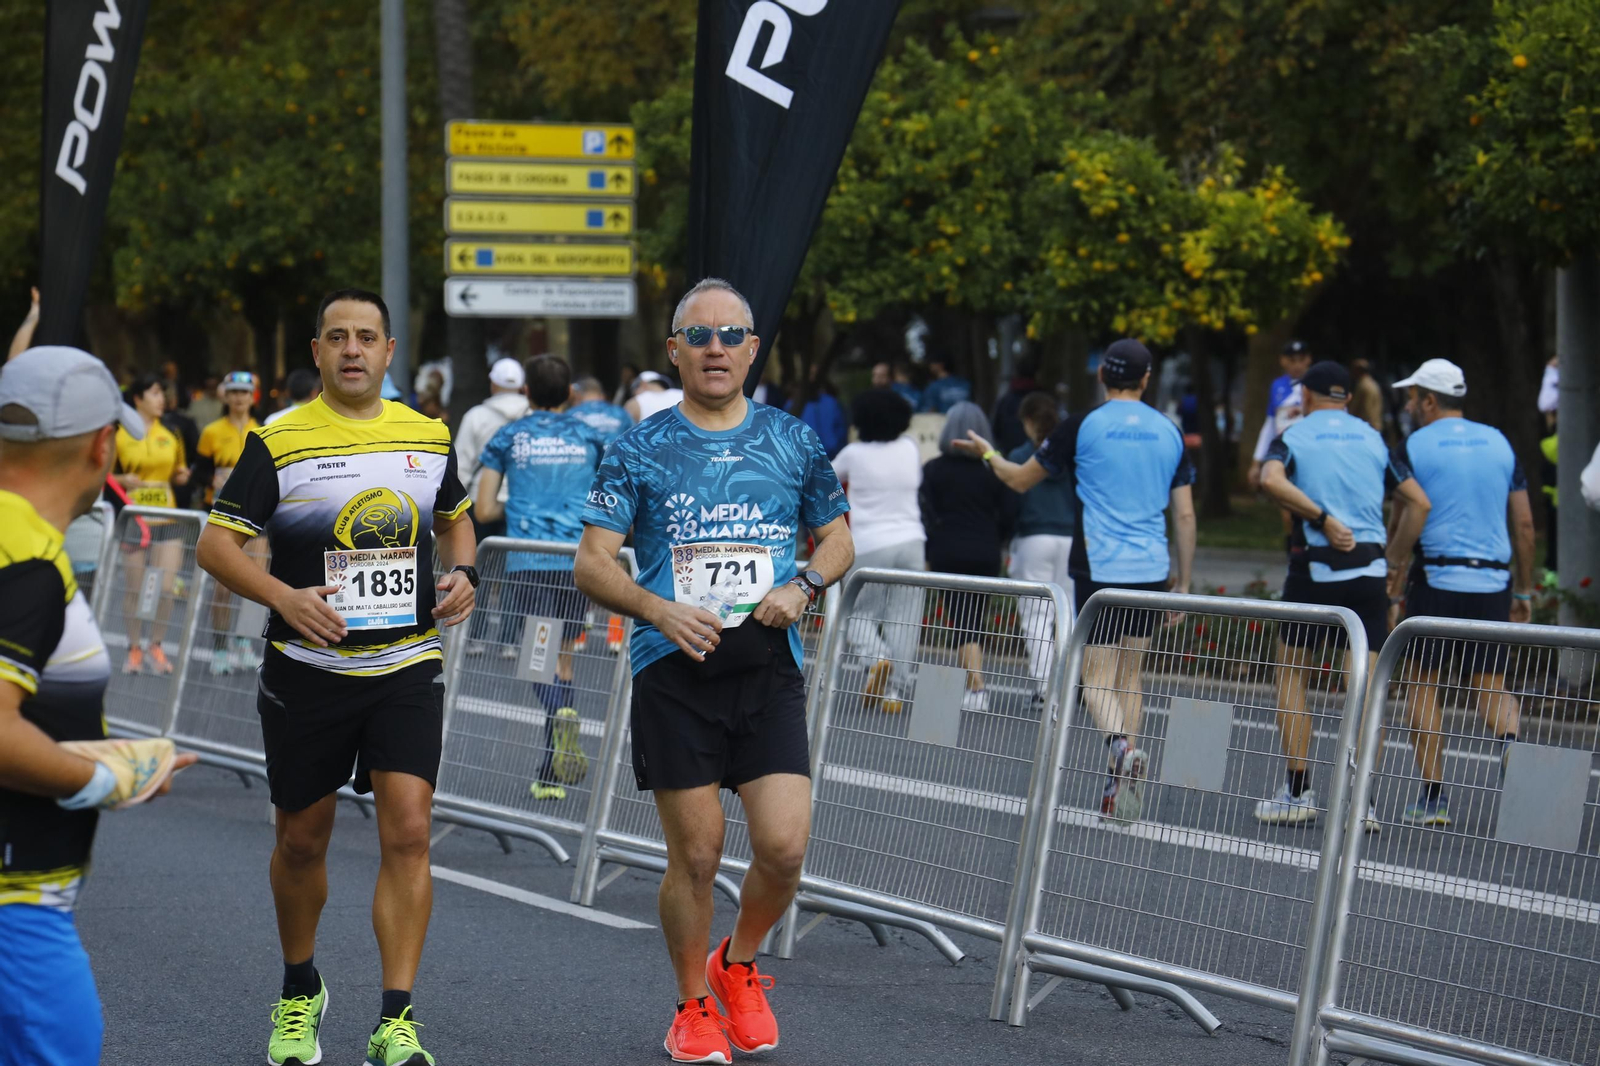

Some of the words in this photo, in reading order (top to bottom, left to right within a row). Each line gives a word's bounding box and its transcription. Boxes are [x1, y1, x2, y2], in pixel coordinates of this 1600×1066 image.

[530, 436, 565, 446] MEDIA
[317, 462, 346, 470] FASTER
[336, 515, 350, 535] CLUB
[349, 490, 383, 516] ATLETISMO
[700, 503, 764, 522] MEDIA
[699, 519, 791, 541] MARATÓN
[328, 554, 348, 569] 38
[350, 553, 377, 562] MEDIA
[380, 549, 414, 560] MARATÓN
[676, 548, 693, 563] 38
[695, 546, 721, 554] MEDIA
[352, 568, 414, 598] 1835
[705, 560, 757, 587] 721
[373, 602, 398, 610] CABALLERO
